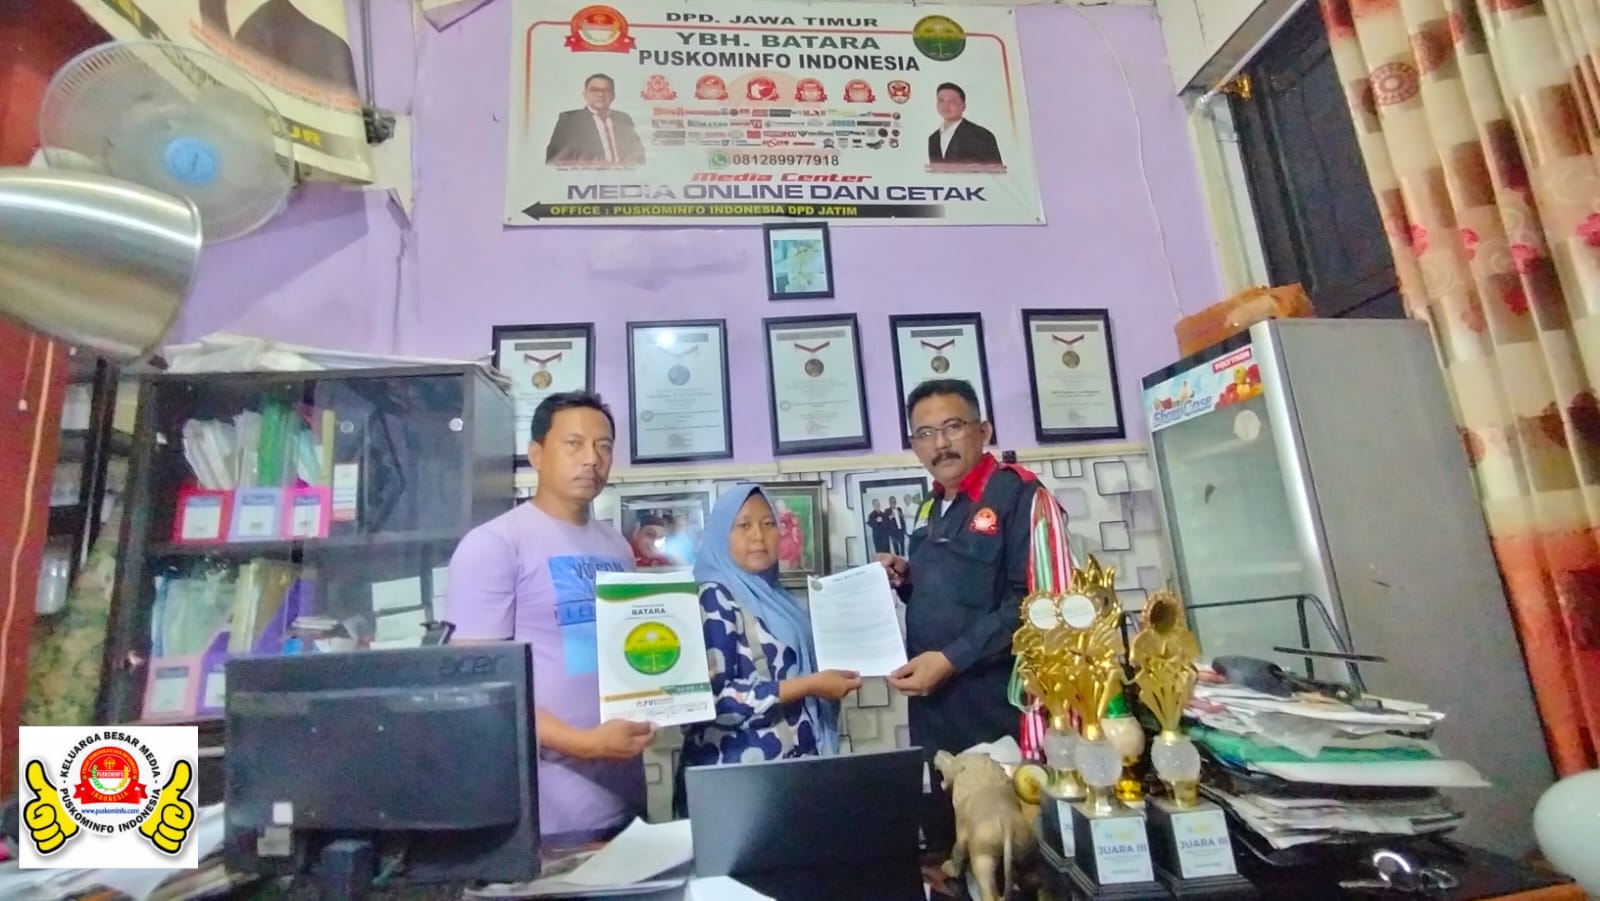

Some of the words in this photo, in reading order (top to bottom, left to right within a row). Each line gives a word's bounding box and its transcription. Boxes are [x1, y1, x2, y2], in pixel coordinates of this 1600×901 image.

[666, 12, 720, 23] DPD.
[729, 14, 796, 25] JAWA
[803, 16, 878, 27] TIMUR
[676, 32, 750, 47] YBH.
[761, 34, 881, 49] BATARA
[638, 50, 791, 69] PUSKOMINFO
[799, 53, 921, 71] INDONESIA
[732, 154, 839, 166] 081289977918
[691, 172, 772, 182] Media
[780, 173, 872, 183] Center
[567, 184, 676, 200] MEDIA
[683, 185, 804, 200] ONLINE
[810, 185, 880, 200] DAN
[886, 186, 988, 201] CETAK
[550, 205, 600, 215] OFFICE
[613, 206, 706, 215] PUSKOMINFO
[709, 205, 785, 215] INDONESIA
[788, 206, 815, 216] DPD
[818, 206, 858, 216] JATIM
[631, 607, 666, 616] BATARA
[439, 654, 507, 677] acer
[1098, 844, 1134, 855] JUARA
[1179, 838, 1215, 850] JUARA
